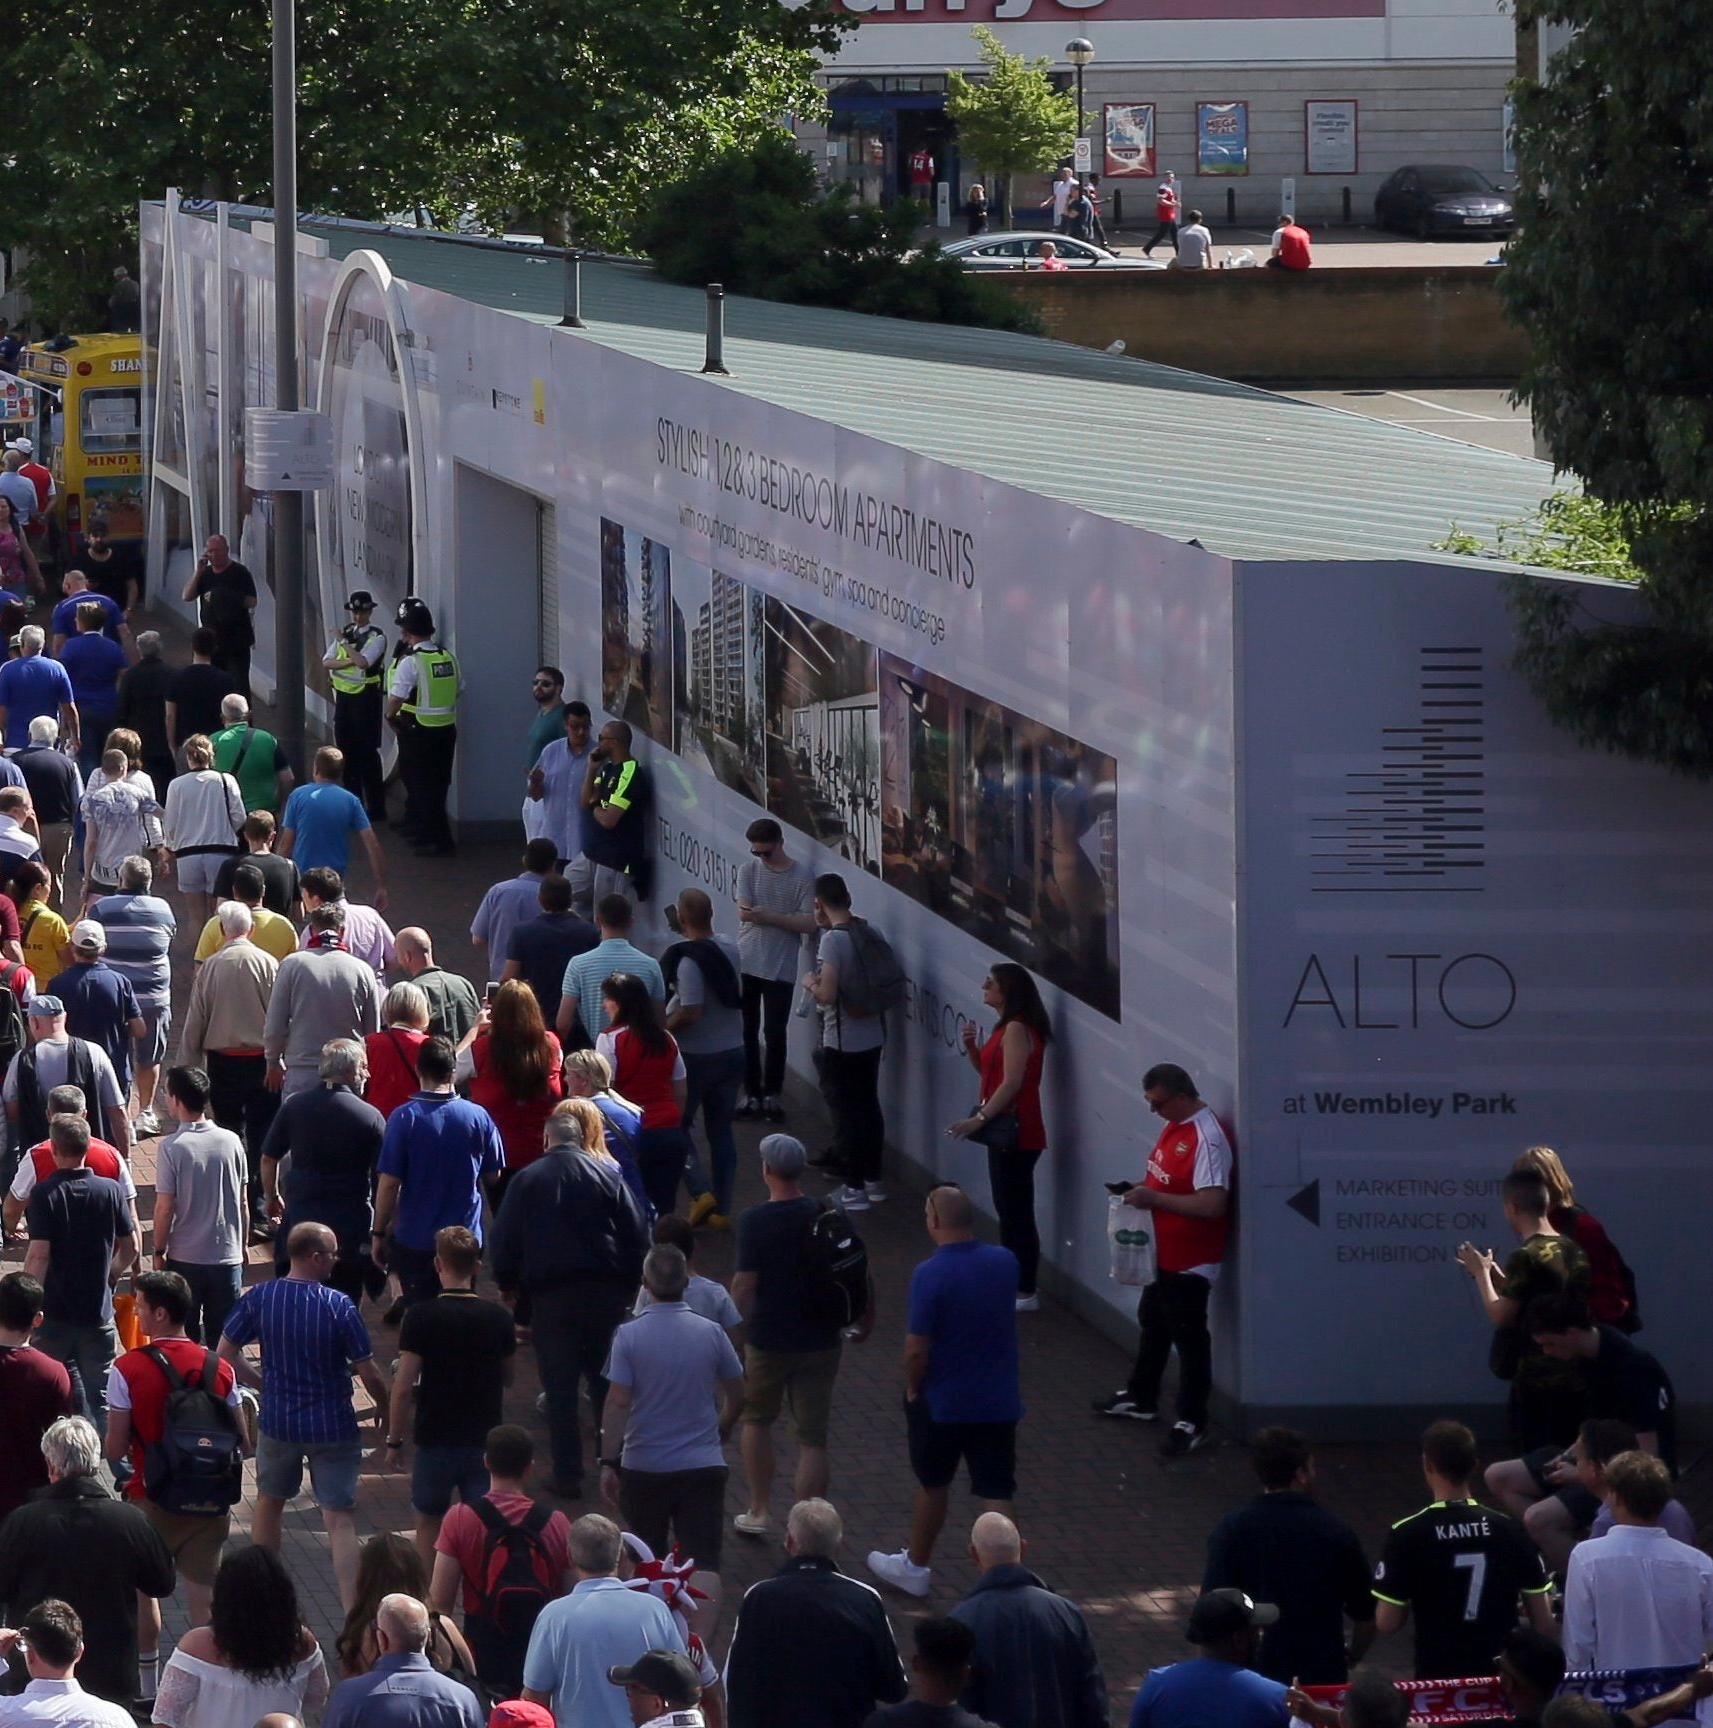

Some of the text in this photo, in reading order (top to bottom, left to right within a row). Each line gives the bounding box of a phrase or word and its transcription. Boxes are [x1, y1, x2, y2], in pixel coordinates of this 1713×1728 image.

[1205, 118, 1238, 129] MEGA
[913, 160, 925, 170] 14
[86, 454, 128, 467] MIND
[656, 417, 710, 482] STYLISH
[759, 455, 848, 539] BEDROOM
[853, 491, 975, 590] APARTMENTS
[847, 579, 866, 608] spa
[867, 585, 888, 611] and
[891, 592, 945, 646] concierge
[679, 831, 700, 878] 020
[703, 842, 726, 896] 3151
[1282, 953, 1516, 1030] ALTO
[1283, 1091, 1517, 1118] at Wembley Park
[1336, 1179, 1504, 1197] MARKETING SUIT
[1336, 1211, 1487, 1230] ENTRANCE ON
[1336, 1244, 1447, 1263] EXHIBITION
[1435, 1517, 1491, 1541] KANTÉ
[1453, 1552, 1486, 1621] 7
[1435, 1676, 1493, 1688] THE CUP
